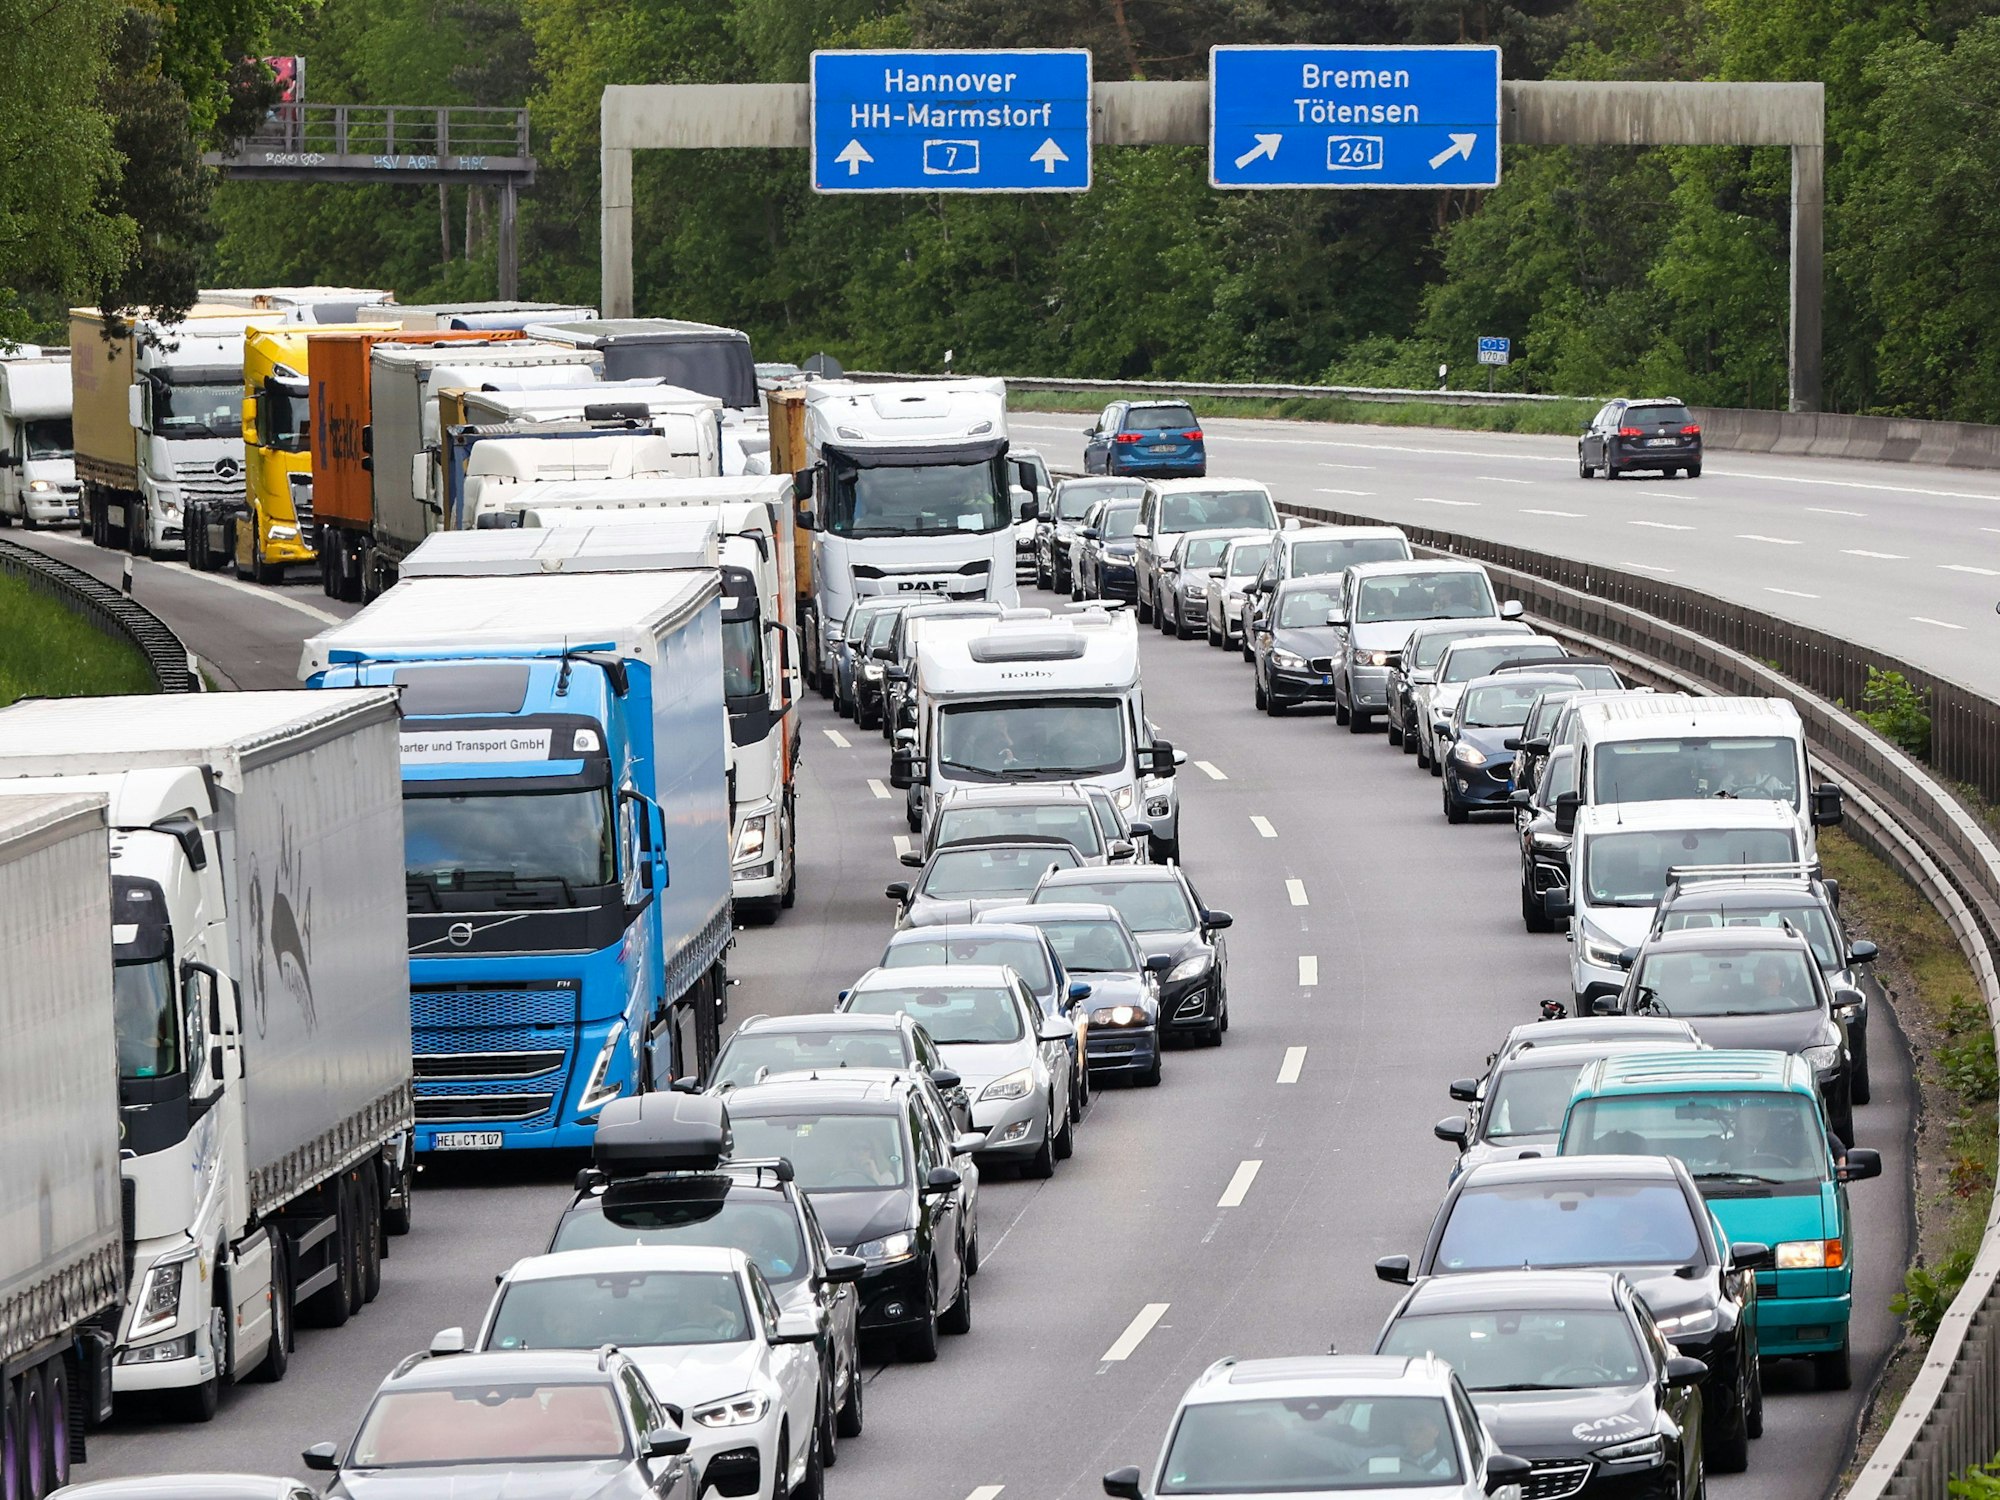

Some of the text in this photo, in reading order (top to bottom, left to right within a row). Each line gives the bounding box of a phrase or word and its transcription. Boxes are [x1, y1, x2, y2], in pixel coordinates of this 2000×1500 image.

[884, 68, 1017, 93] Hannover
[1302, 63, 1409, 89] Bremen
[850, 103, 1052, 129] HH-Marmstorf
[1293, 98, 1419, 124] Tötensen
[945, 146, 958, 168] 7
[1338, 142, 1373, 163] 261
[1499, 340, 1505, 350] S
[898, 581, 948, 591] DAF
[1001, 671, 1055, 680] Hobby
[432, 741, 452, 751] und
[456, 739, 507, 753] Transport
[510, 739, 545, 750] GmbH
[437, 1133, 499, 1147] HEI CT 107
